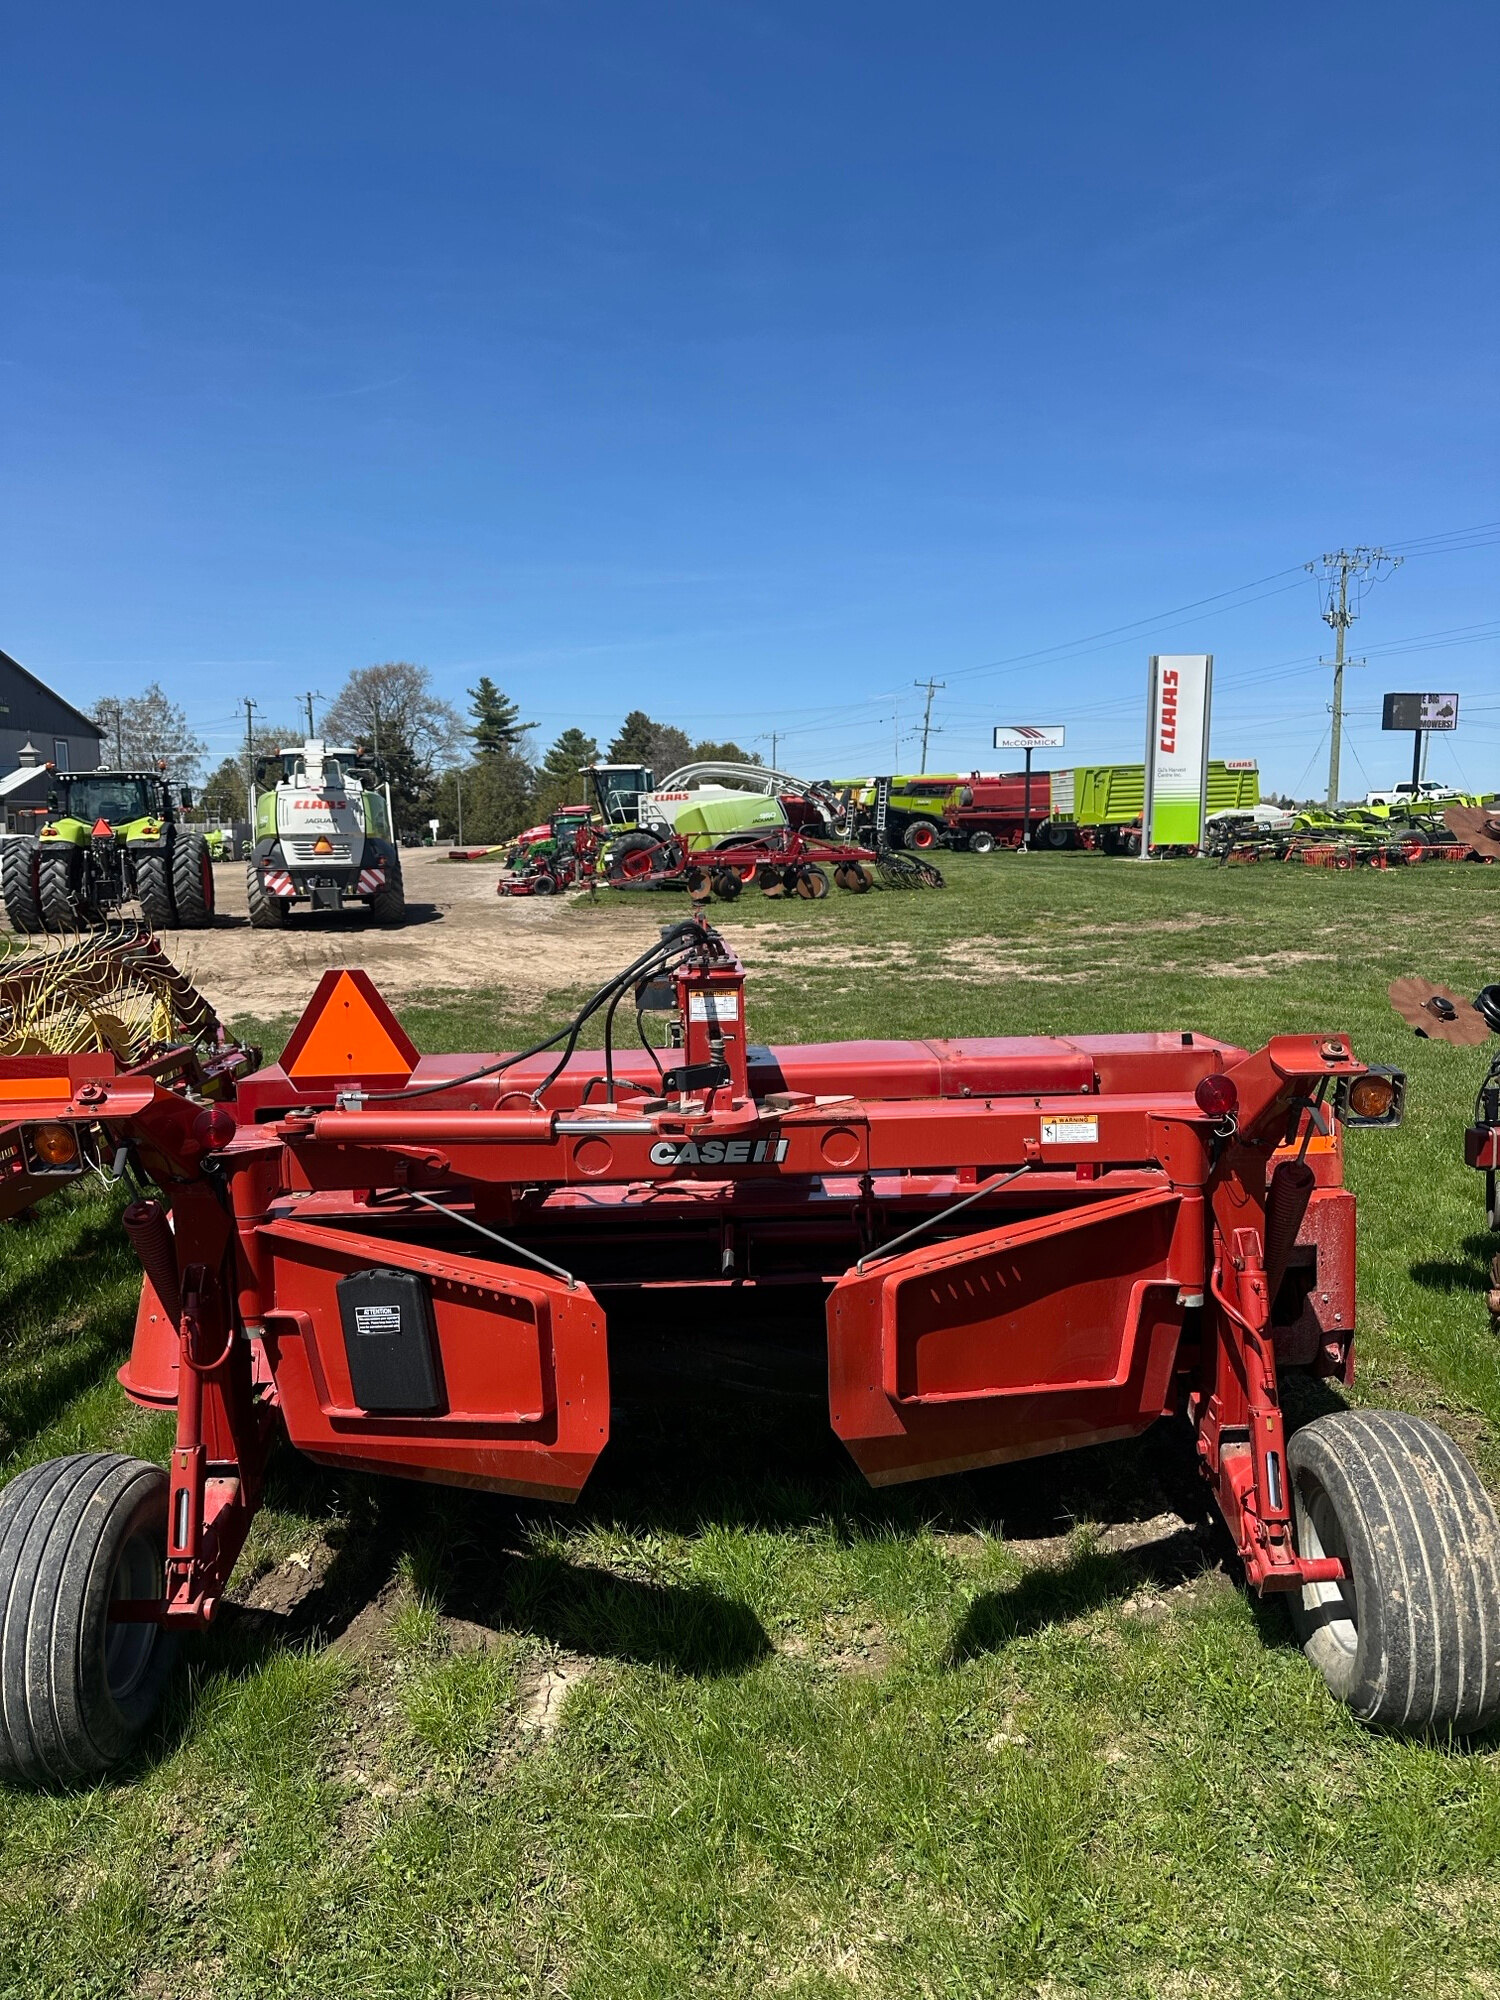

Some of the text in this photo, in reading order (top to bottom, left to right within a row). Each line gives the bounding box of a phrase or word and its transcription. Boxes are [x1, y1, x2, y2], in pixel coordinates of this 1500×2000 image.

[1160, 669, 1179, 754] CLAAS
[1420, 719, 1453, 728] MOWERS!
[654, 793, 690, 801] CLAAS
[293, 800, 347, 810] CLAAS
[649, 1140, 751, 1165] CASE
